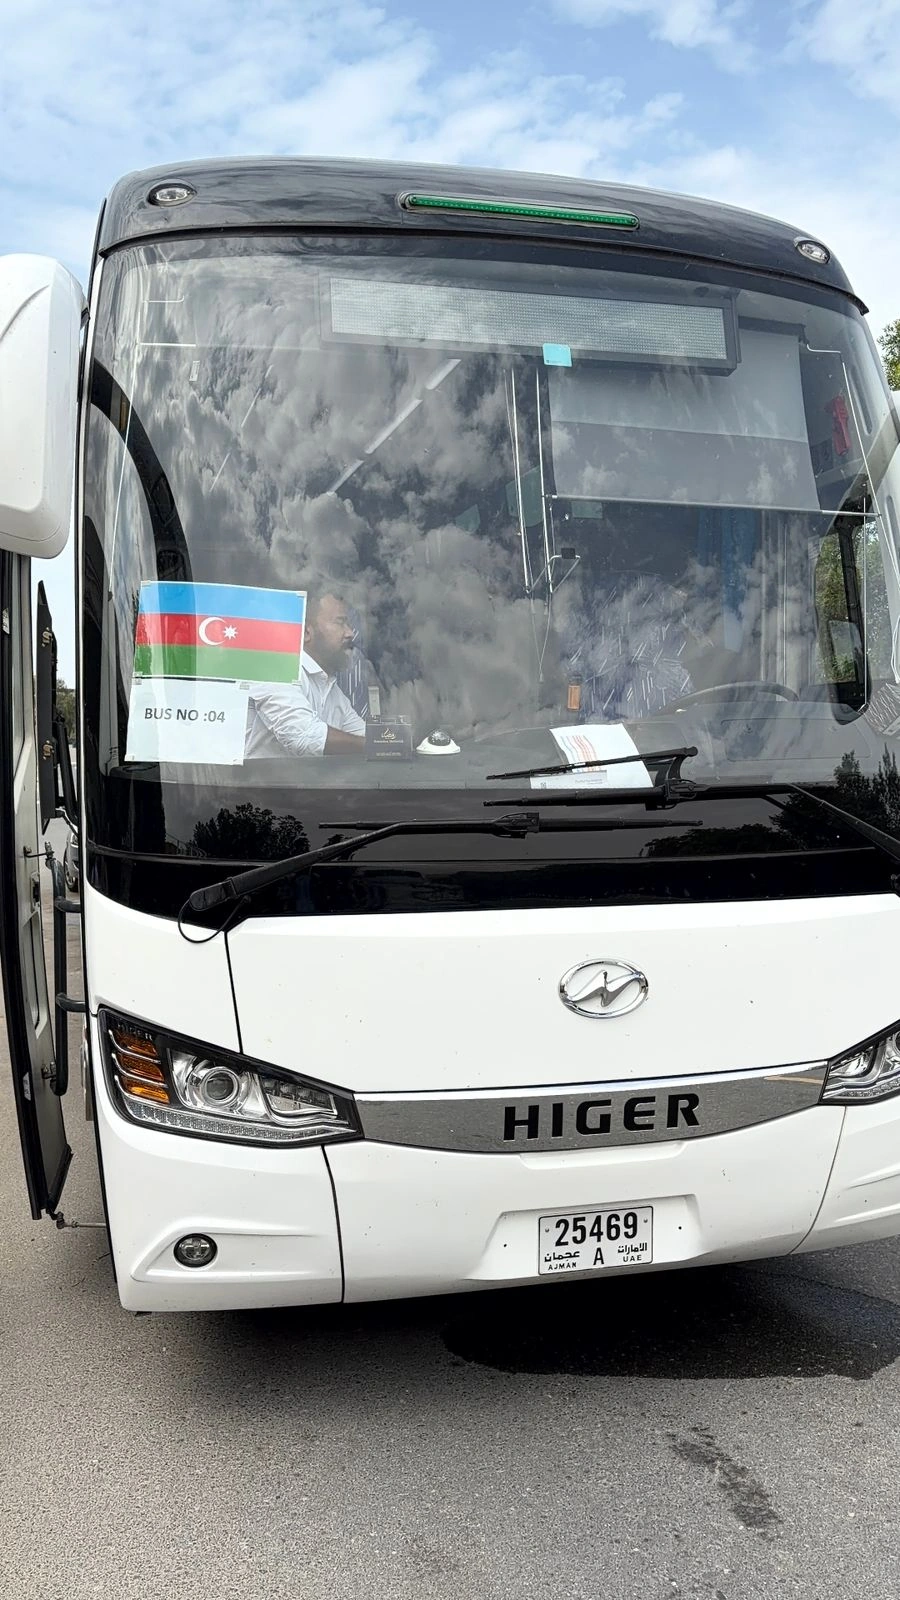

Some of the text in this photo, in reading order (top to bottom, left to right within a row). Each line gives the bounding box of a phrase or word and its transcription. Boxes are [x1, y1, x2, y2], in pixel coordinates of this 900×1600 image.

[144, 707, 225, 723] BUS NO :04
[503, 1093, 700, 1141] HIGER
[554, 1212, 638, 1247] 25469
[544, 1250, 580, 1262] عجمان
[592, 1247, 605, 1266] A
[622, 1254, 642, 1263] UAE
[548, 1261, 577, 1271] AJMAN
